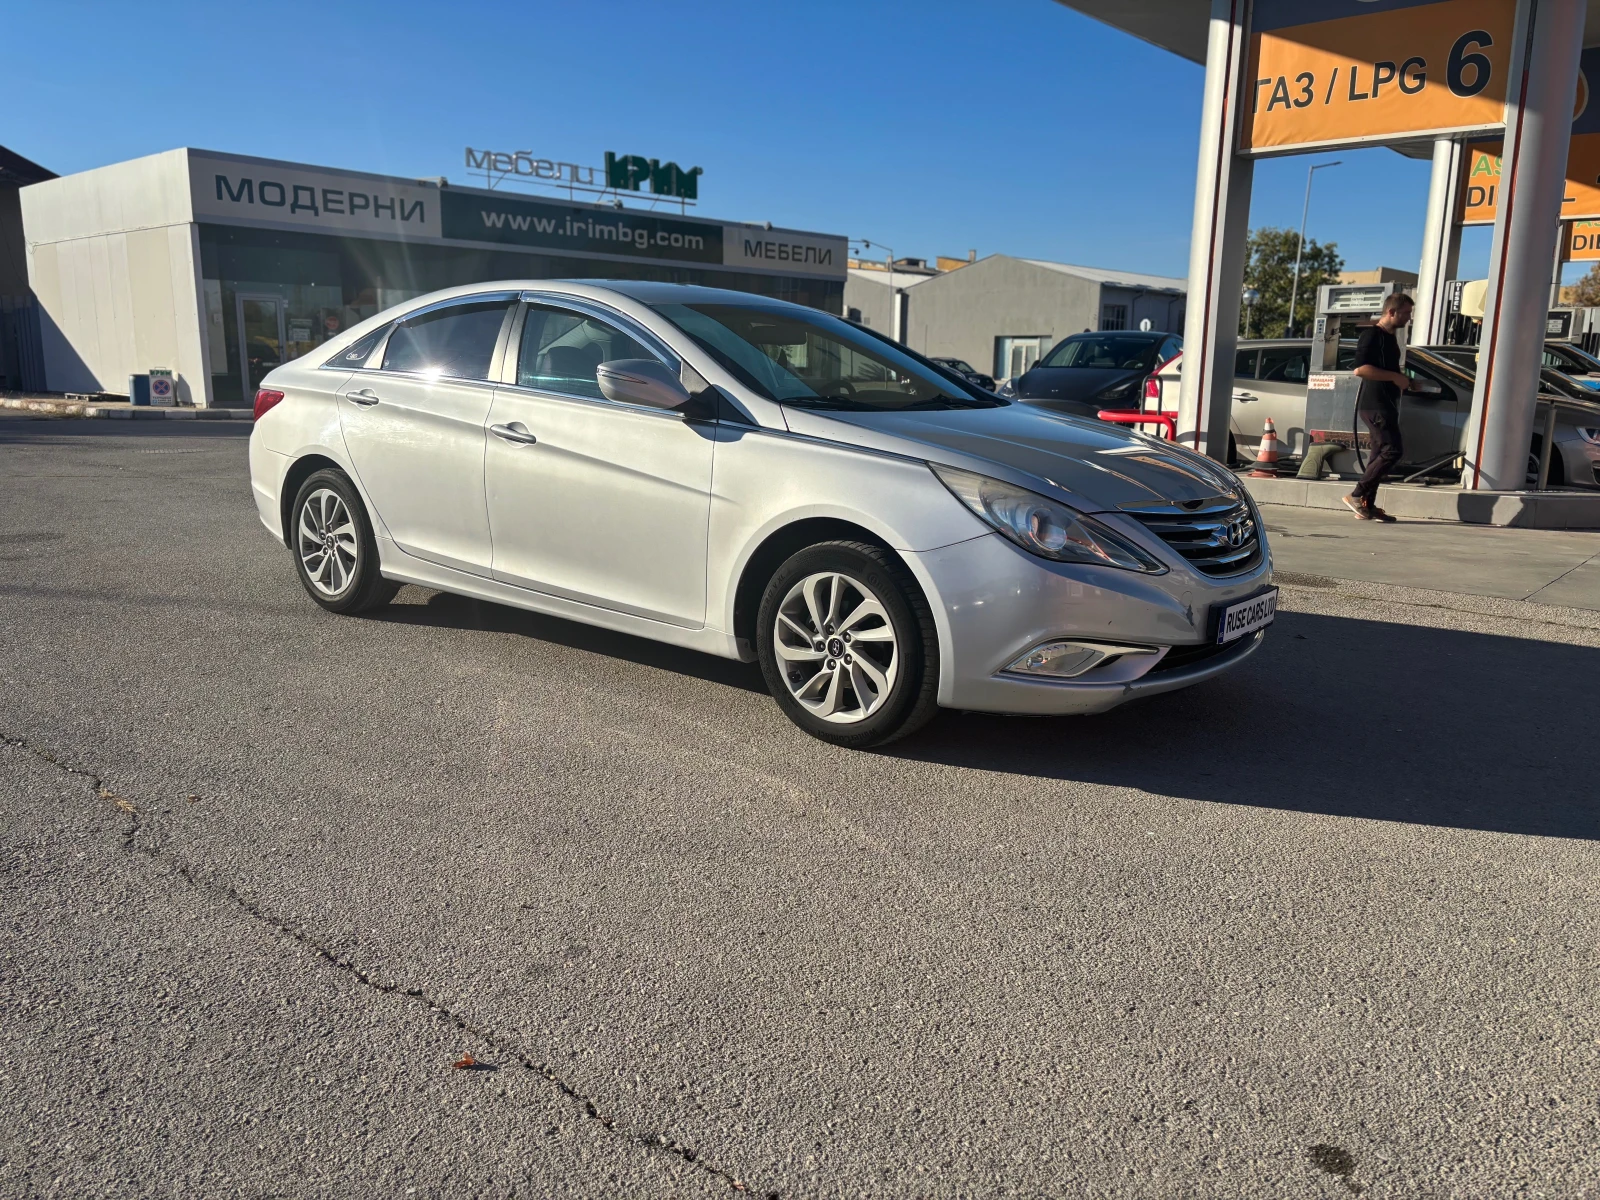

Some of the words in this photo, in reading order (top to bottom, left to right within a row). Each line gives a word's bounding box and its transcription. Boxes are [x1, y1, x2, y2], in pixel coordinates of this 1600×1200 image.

[1348, 56, 1427, 102] LPG
[1446, 29, 1493, 98] 6
[215, 174, 425, 223] МОДЕРНИ
[481, 211, 704, 250] www.irimbg.com
[744, 239, 832, 267] МЕБЕЛИ
[1453, 282, 1462, 311] DIESEL
[1226, 608, 1248, 633] RUSE
[1246, 601, 1265, 626] CARS
